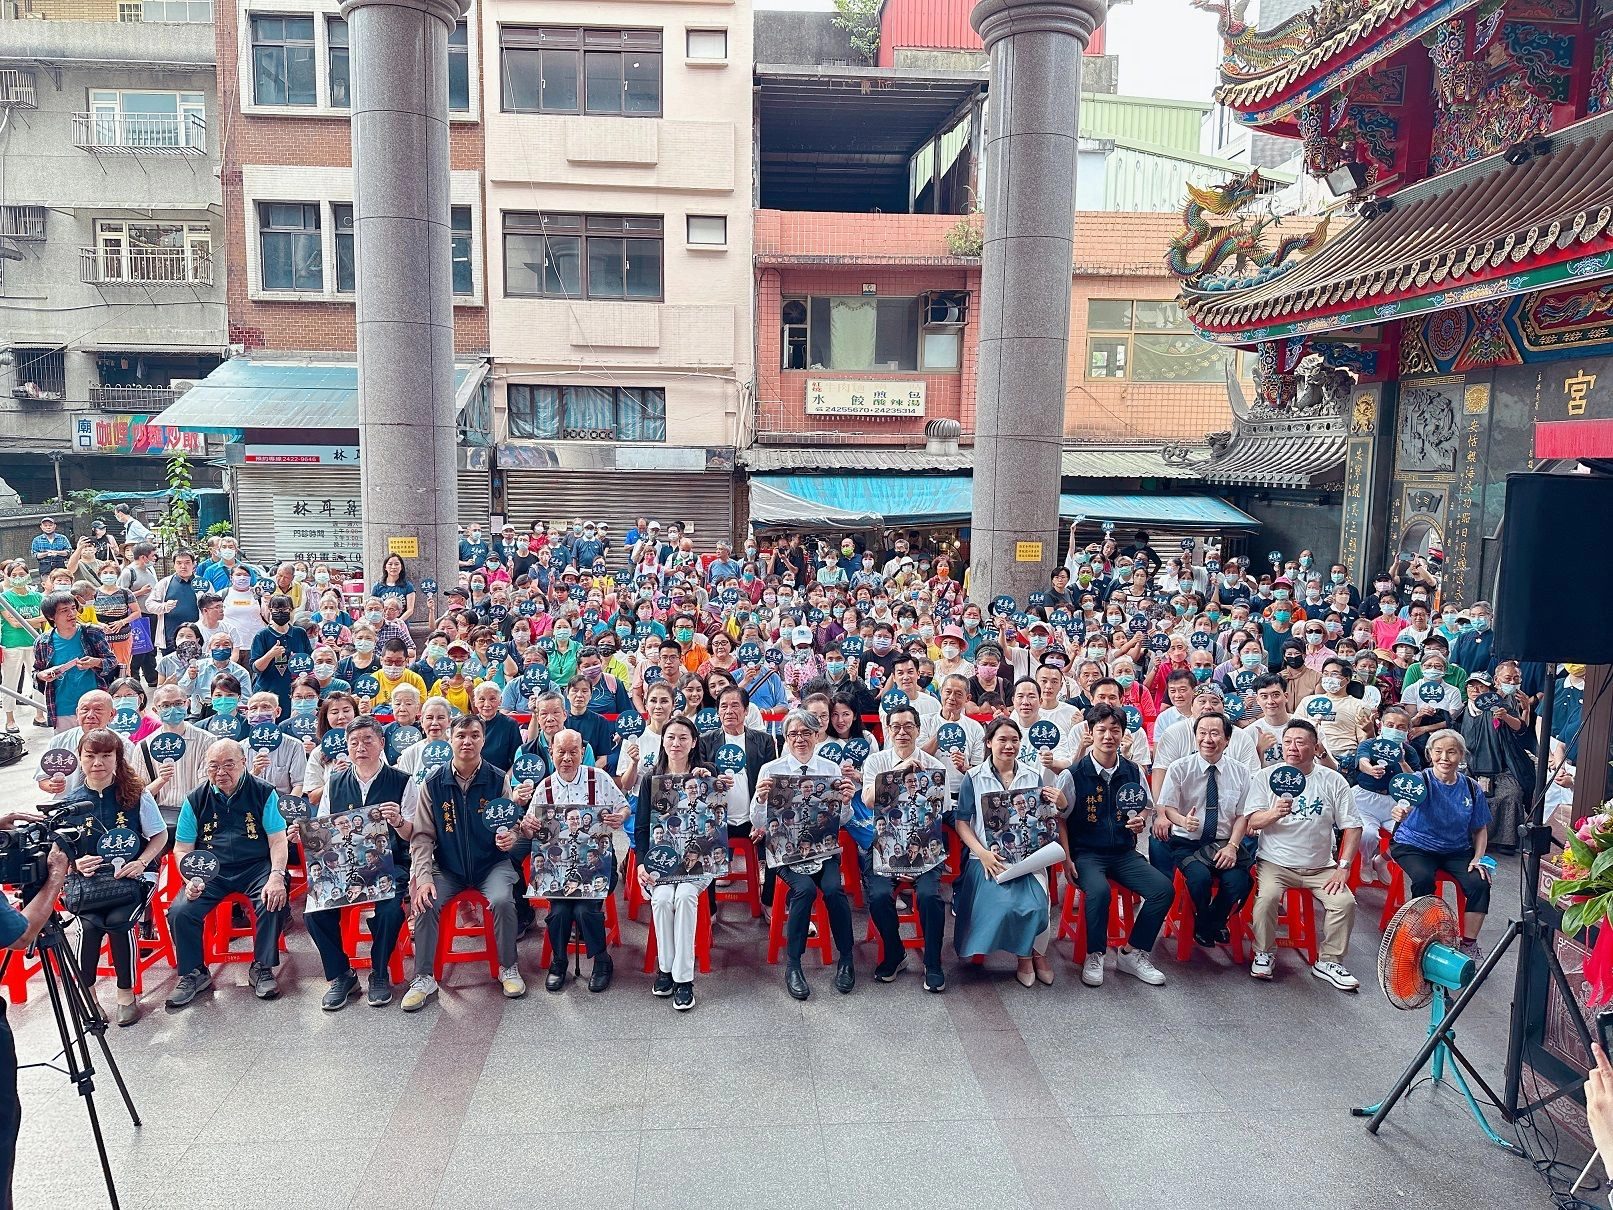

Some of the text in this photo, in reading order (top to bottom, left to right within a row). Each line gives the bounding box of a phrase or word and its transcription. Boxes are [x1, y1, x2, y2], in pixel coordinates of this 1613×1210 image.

[1564, 368, 1597, 416] 宮
[77, 418, 92, 447] 廟口
[1291, 795, 1324, 817] 尋者
